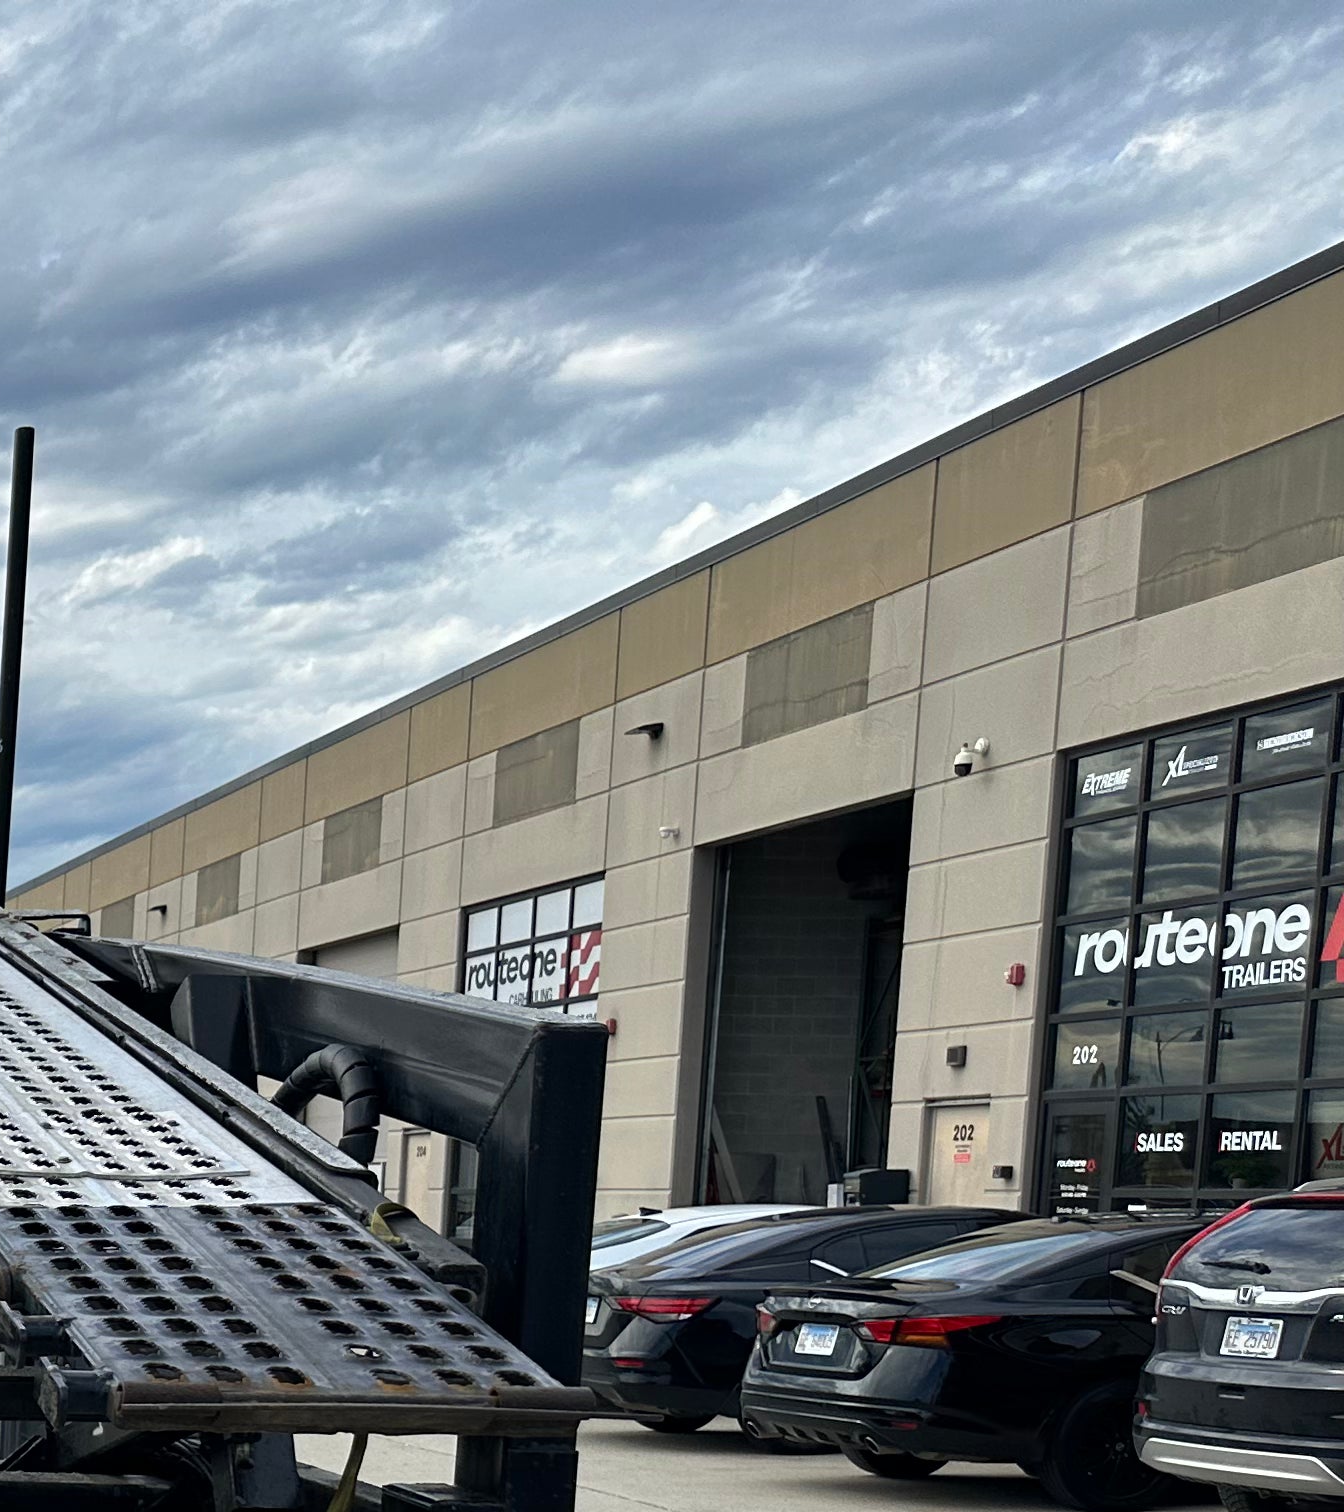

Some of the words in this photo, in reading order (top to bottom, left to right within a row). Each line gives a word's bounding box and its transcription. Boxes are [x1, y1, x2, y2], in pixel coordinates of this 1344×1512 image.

[1081, 767, 1132, 796] EXTREME
[1073, 903, 1311, 977] routeone
[467, 948, 557, 992] routeone
[1222, 957, 1307, 990] TRAILERS
[1072, 1045, 1099, 1065] 202
[952, 1124, 975, 1142] 202
[1136, 1132, 1185, 1152] SALES
[1220, 1130, 1282, 1151] RENTAL
